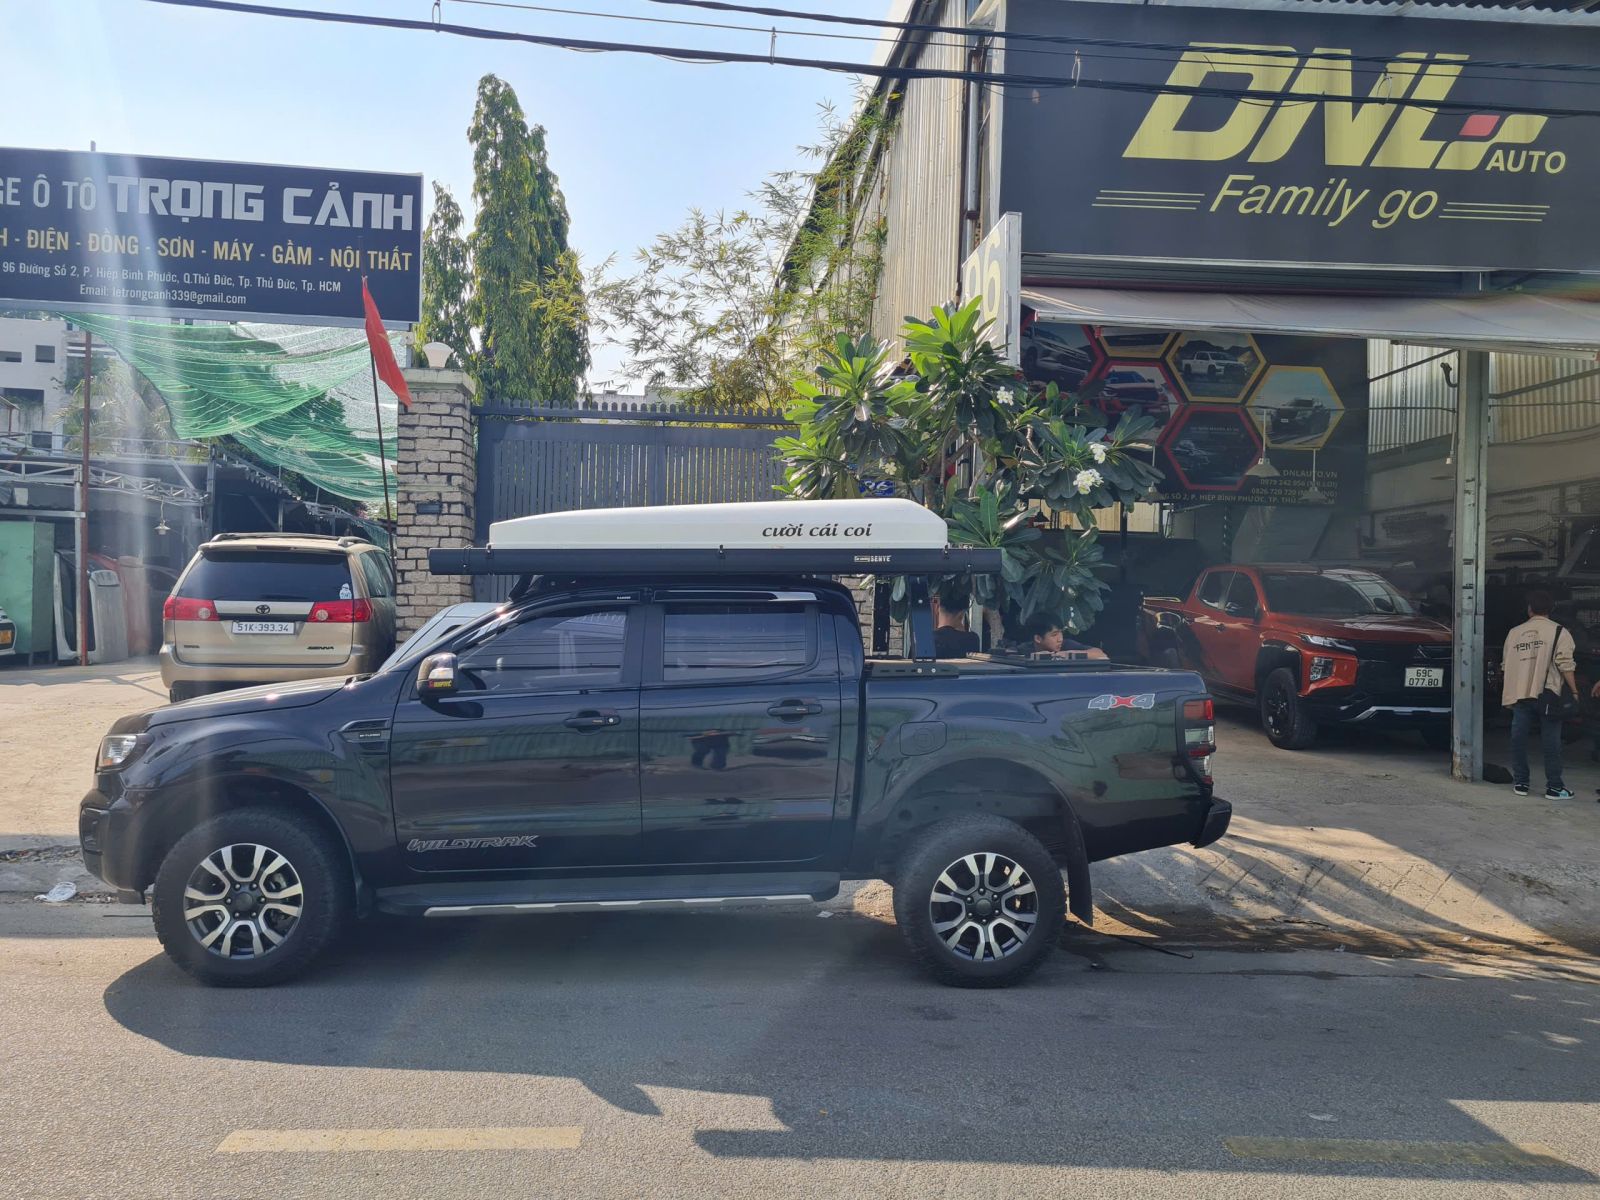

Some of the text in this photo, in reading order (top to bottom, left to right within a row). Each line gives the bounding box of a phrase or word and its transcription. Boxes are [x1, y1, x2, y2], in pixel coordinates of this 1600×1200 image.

[1121, 42, 1471, 170] DNL
[1485, 150, 1566, 174] AUTO
[33, 174, 49, 208] Ô
[62, 177, 96, 211] TÔ
[107, 175, 265, 223] TRỌNG
[283, 182, 414, 231] CẢNH
[1209, 174, 1438, 229] Family go
[27, 227, 69, 254] ĐIỆN
[88, 227, 139, 256] ĐỒNG
[158, 236, 195, 258] SƠN
[213, 238, 254, 262] MÁY
[272, 239, 312, 266] GẦM
[330, 246, 360, 271] NỘI
[367, 245, 412, 271] THẤT
[2, 261, 16, 273] 96
[19, 262, 51, 278] Đường
[54, 264, 67, 276] Số
[70, 265, 80, 278] 2,
[83, 266, 93, 278] P.
[183, 272, 210, 285] Q.Thủ
[238, 275, 253, 289] Tp.
[256, 276, 274, 289] Thủ
[301, 279, 316, 293] Tp.
[319, 280, 341, 293] HCM
[80, 283, 247, 305] Email: letrongcanh339@gmail.com
[762, 523, 872, 537] cười cái coi
[1408, 677, 1440, 687] 077.80
[1416, 669, 1433, 678] 69C
[406, 834, 540, 853] WILDTRAK
